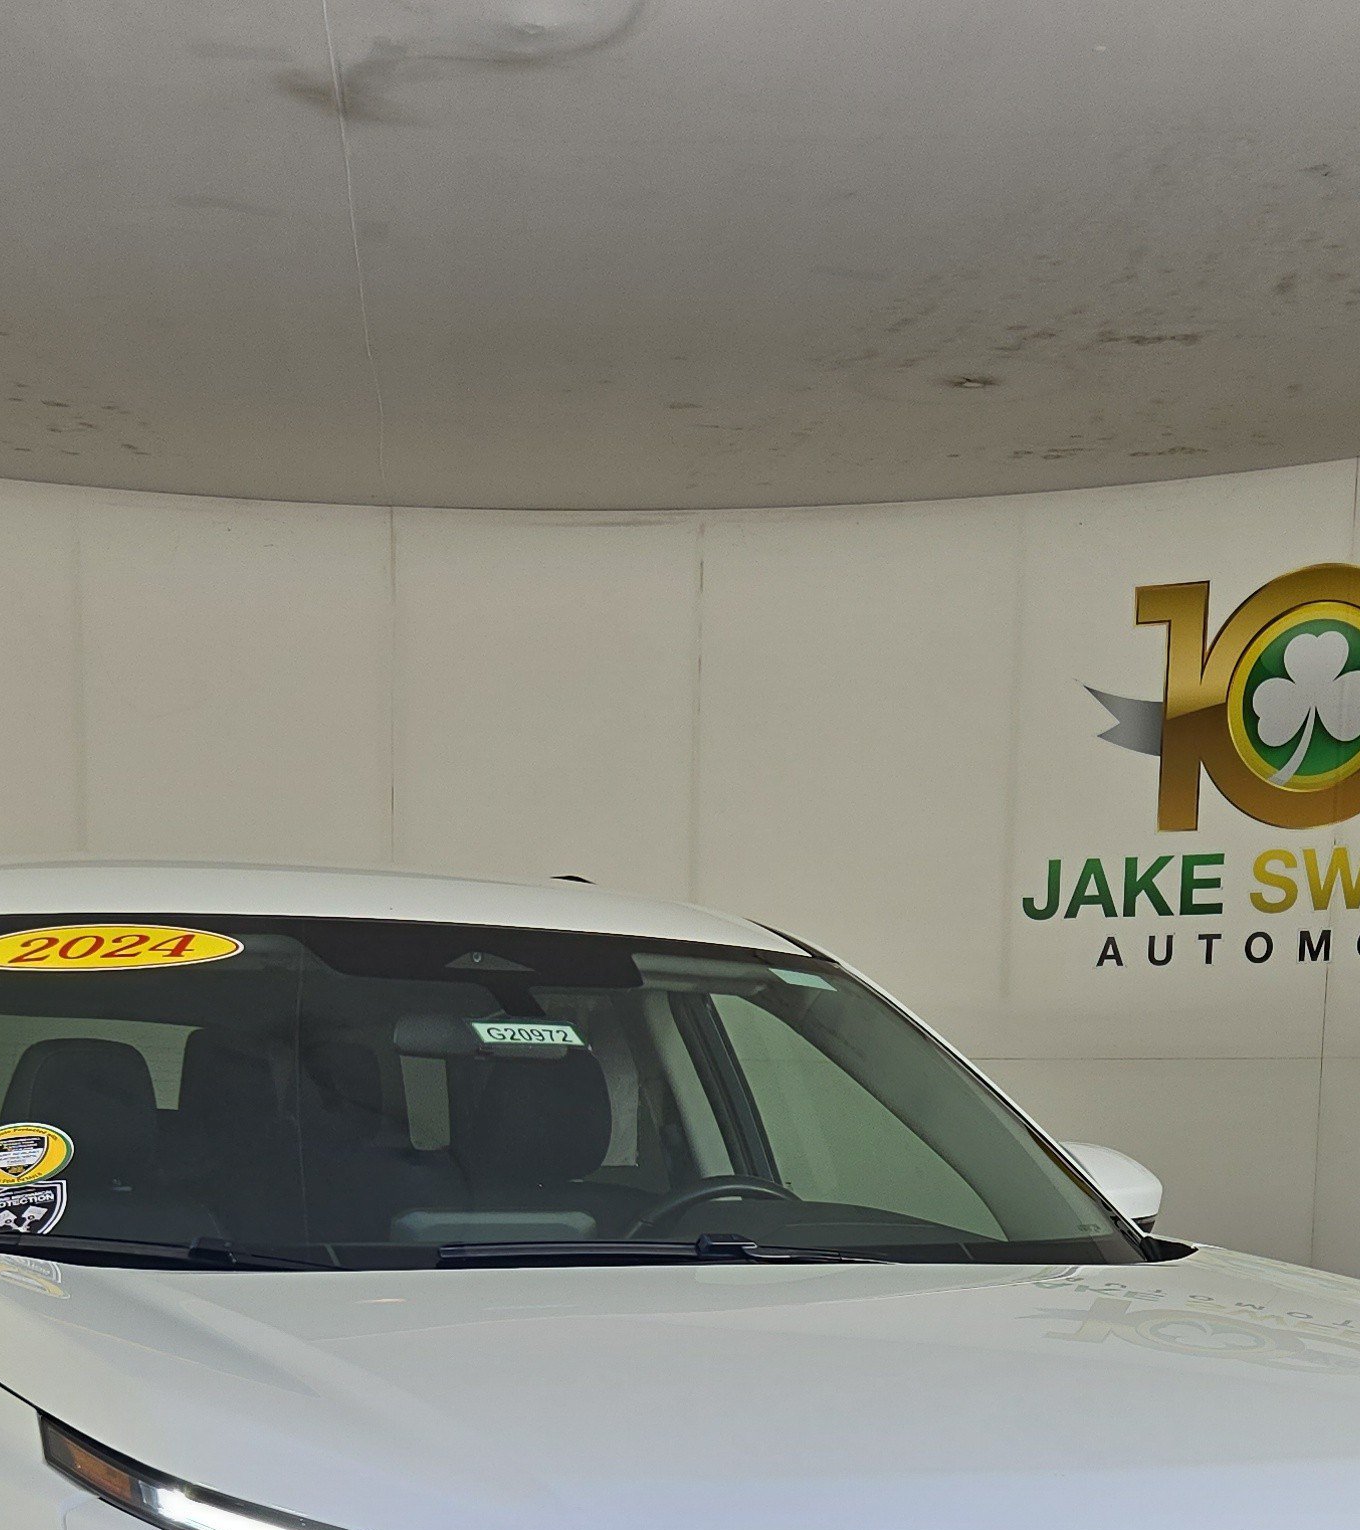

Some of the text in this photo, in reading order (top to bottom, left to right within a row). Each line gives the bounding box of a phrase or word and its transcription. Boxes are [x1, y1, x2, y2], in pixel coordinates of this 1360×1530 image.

[1022, 852, 1226, 921] JAKE
[8, 933, 196, 964] 2024
[486, 1027, 573, 1043] G20972
